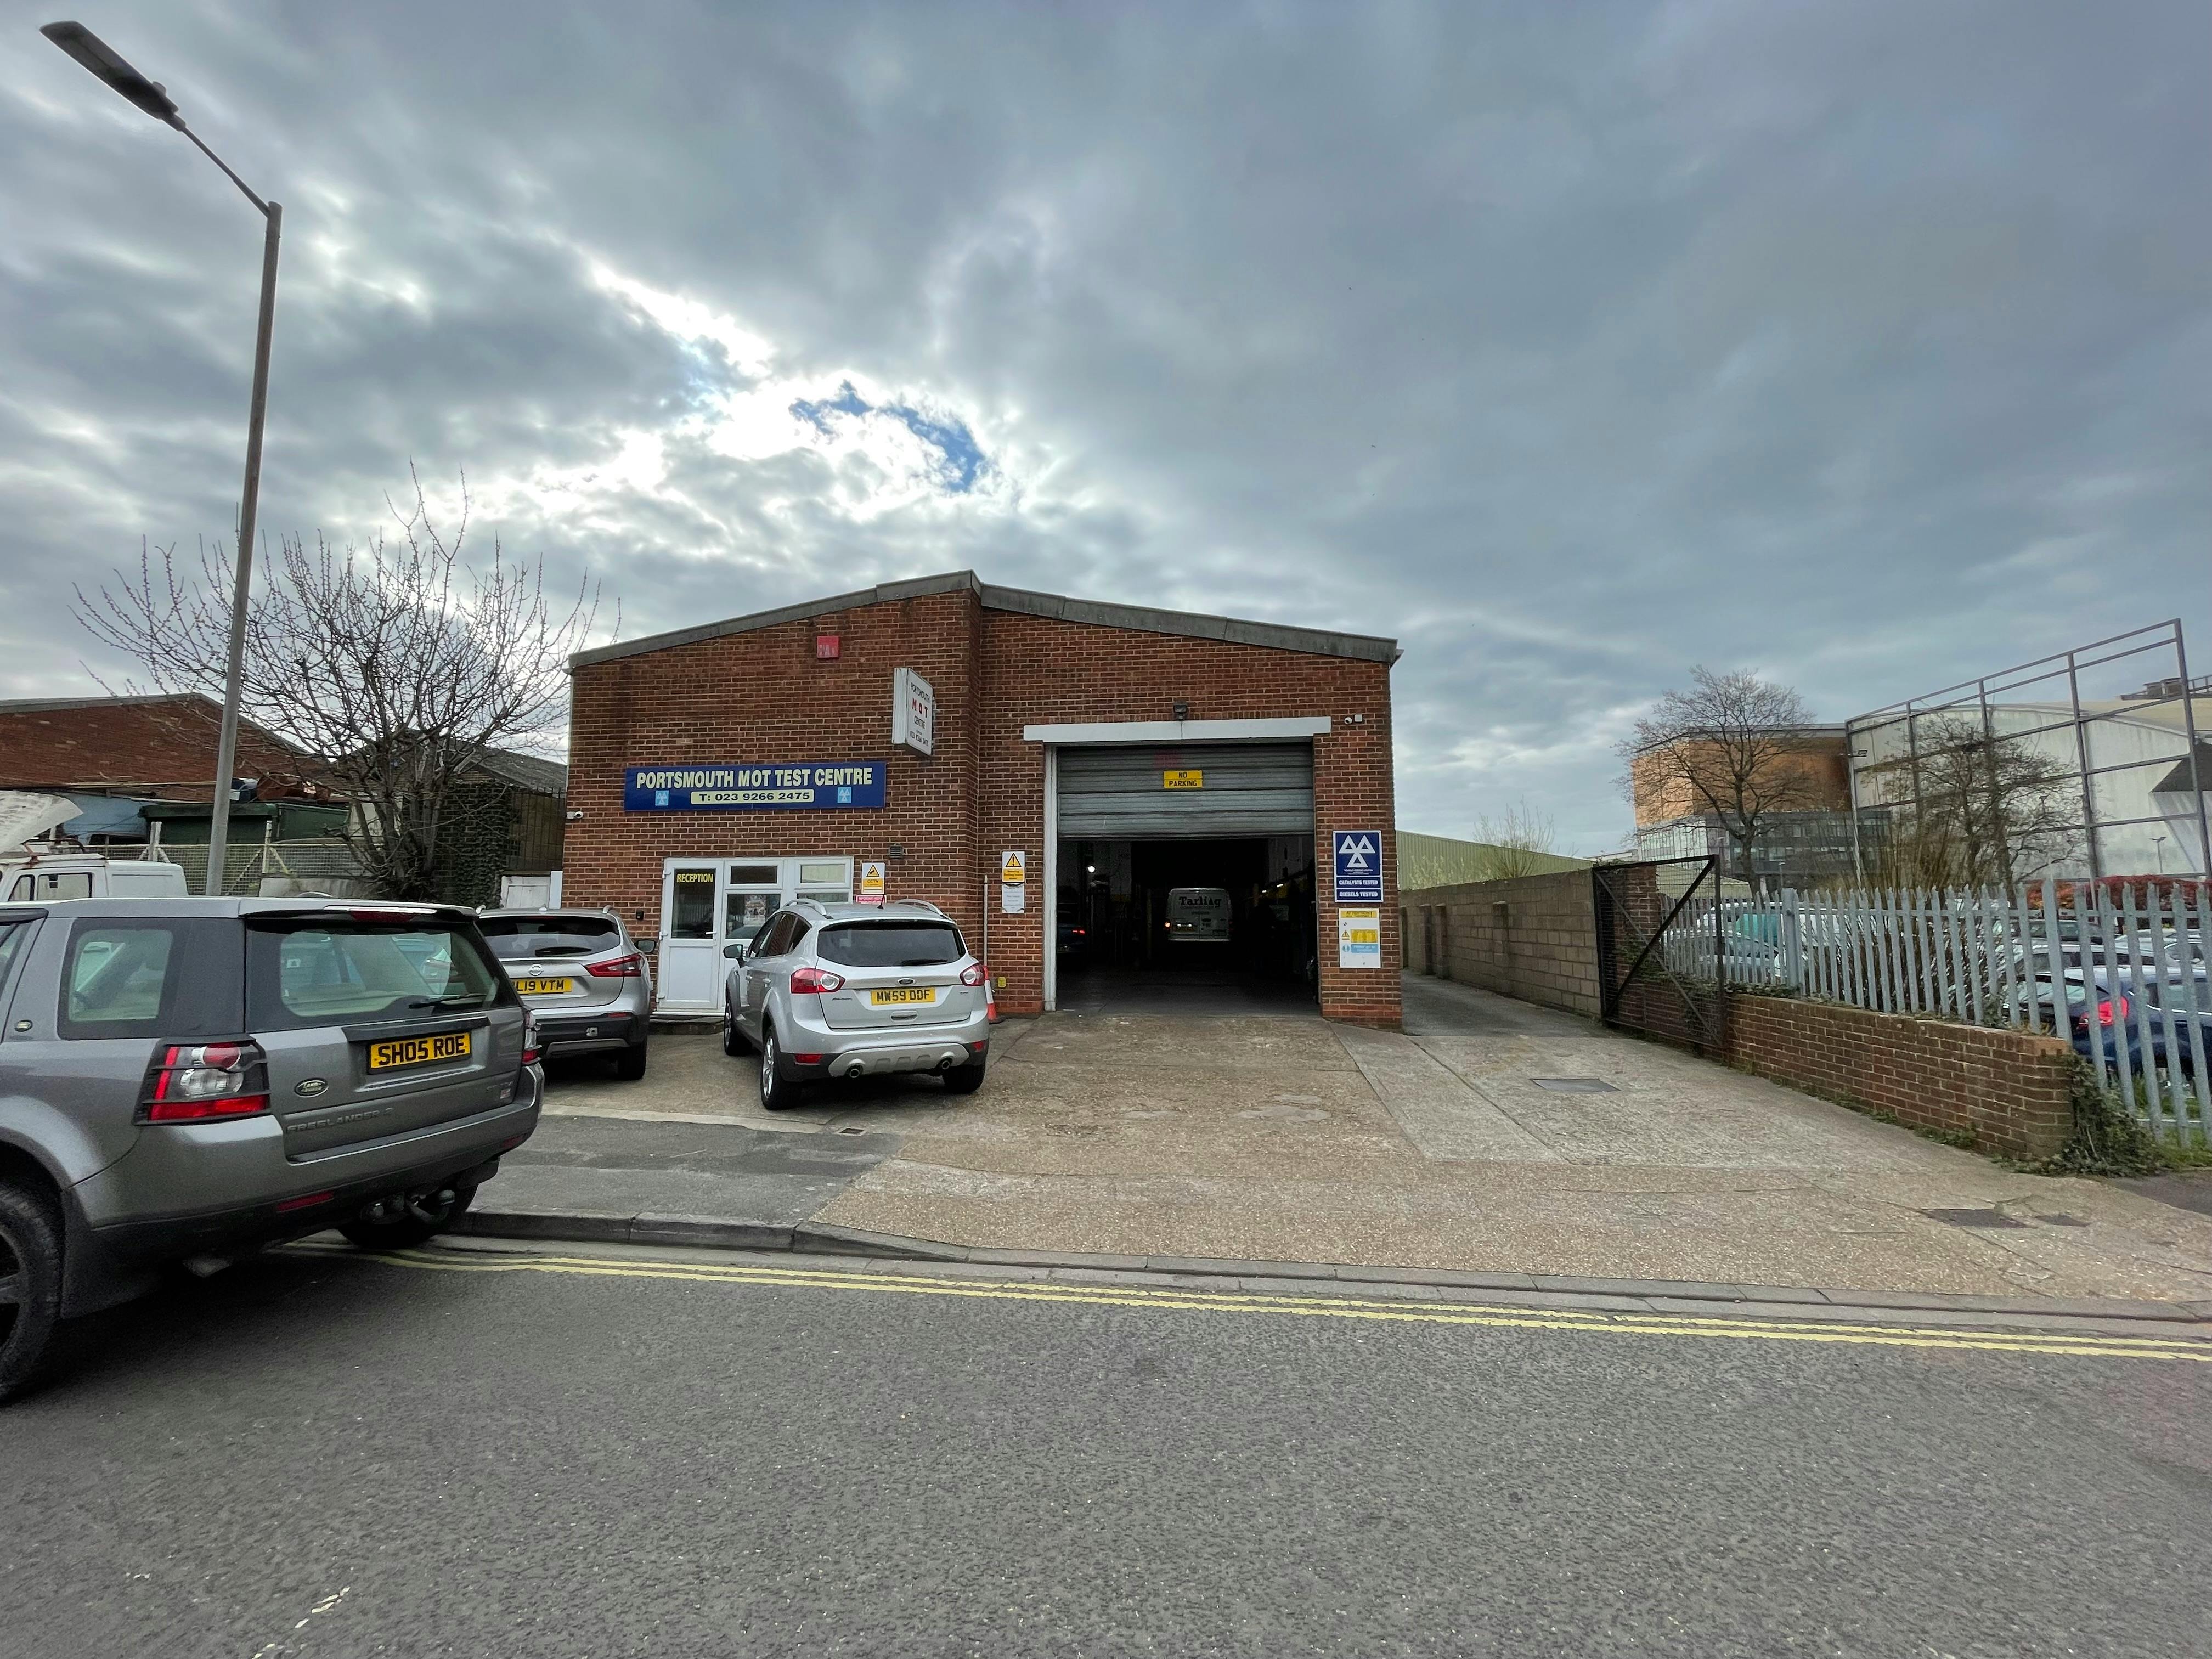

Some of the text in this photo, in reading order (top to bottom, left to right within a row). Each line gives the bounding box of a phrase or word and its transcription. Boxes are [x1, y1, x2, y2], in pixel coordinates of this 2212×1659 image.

[912, 698, 928, 718] MOT
[636, 768, 872, 789] PORTSMOUTH MOT TEST CENTRE
[676, 873, 713, 883] RECEPTION
[540, 980, 564, 991] VTM
[877, 989, 930, 1002] MW59 DDF
[433, 1035, 465, 1058] ROE
[286, 1110, 380, 1133] FREELANDER
